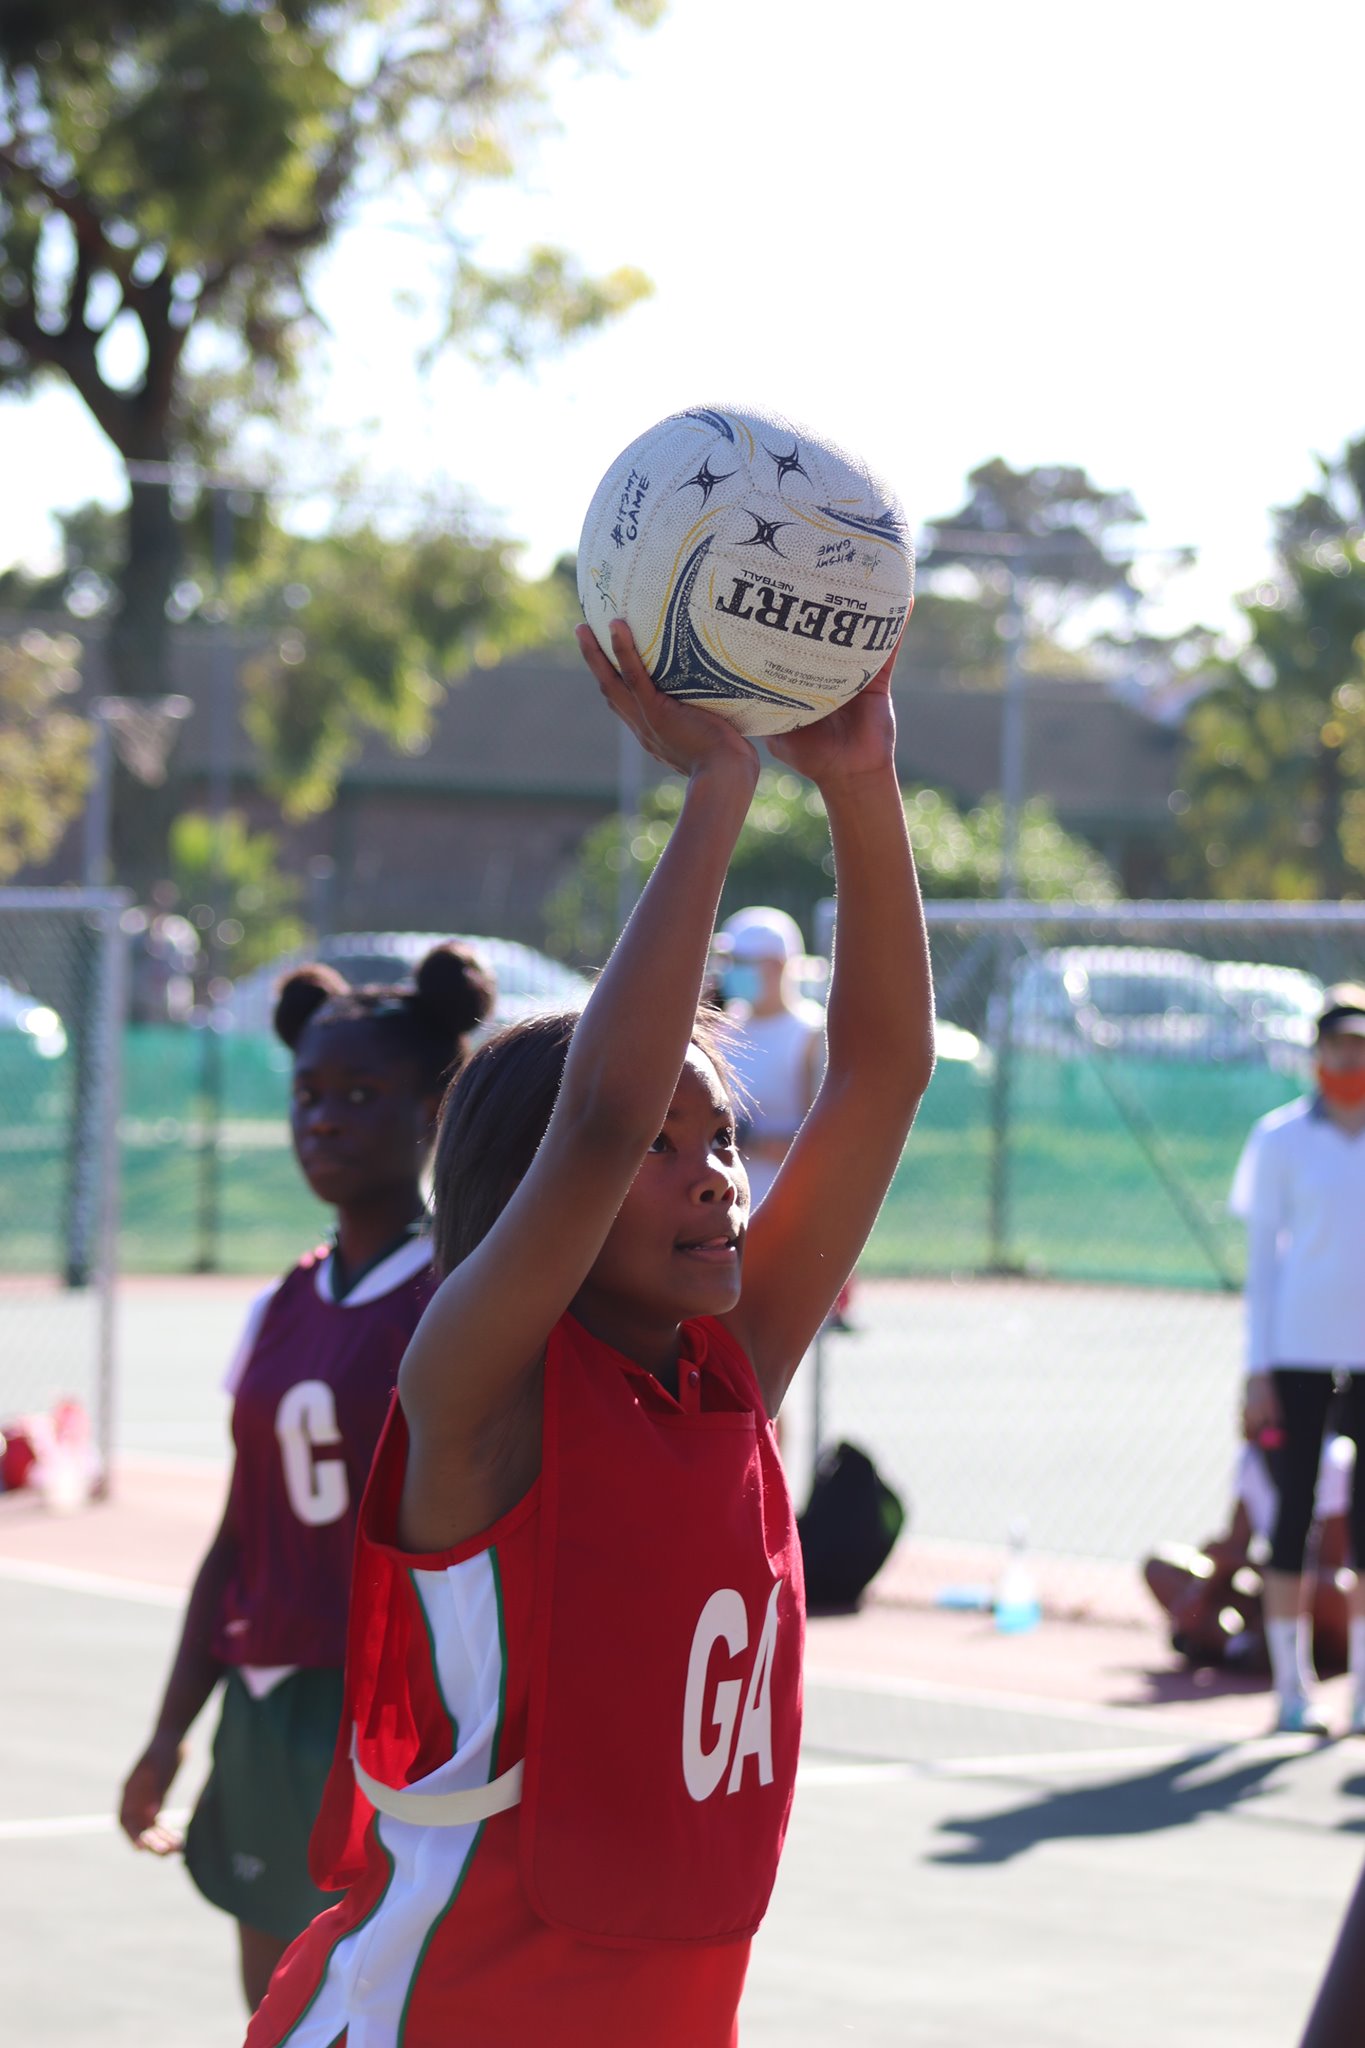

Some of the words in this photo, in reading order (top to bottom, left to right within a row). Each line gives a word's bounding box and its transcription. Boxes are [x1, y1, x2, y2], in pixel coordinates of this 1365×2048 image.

[626, 474, 650, 541] GAME
[816, 539, 851, 556] GAME
[740, 568, 795, 593] NETBALL
[824, 593, 868, 611] PULSE
[763, 659, 793, 675] NETBALL
[682, 1579, 783, 1803] GA
